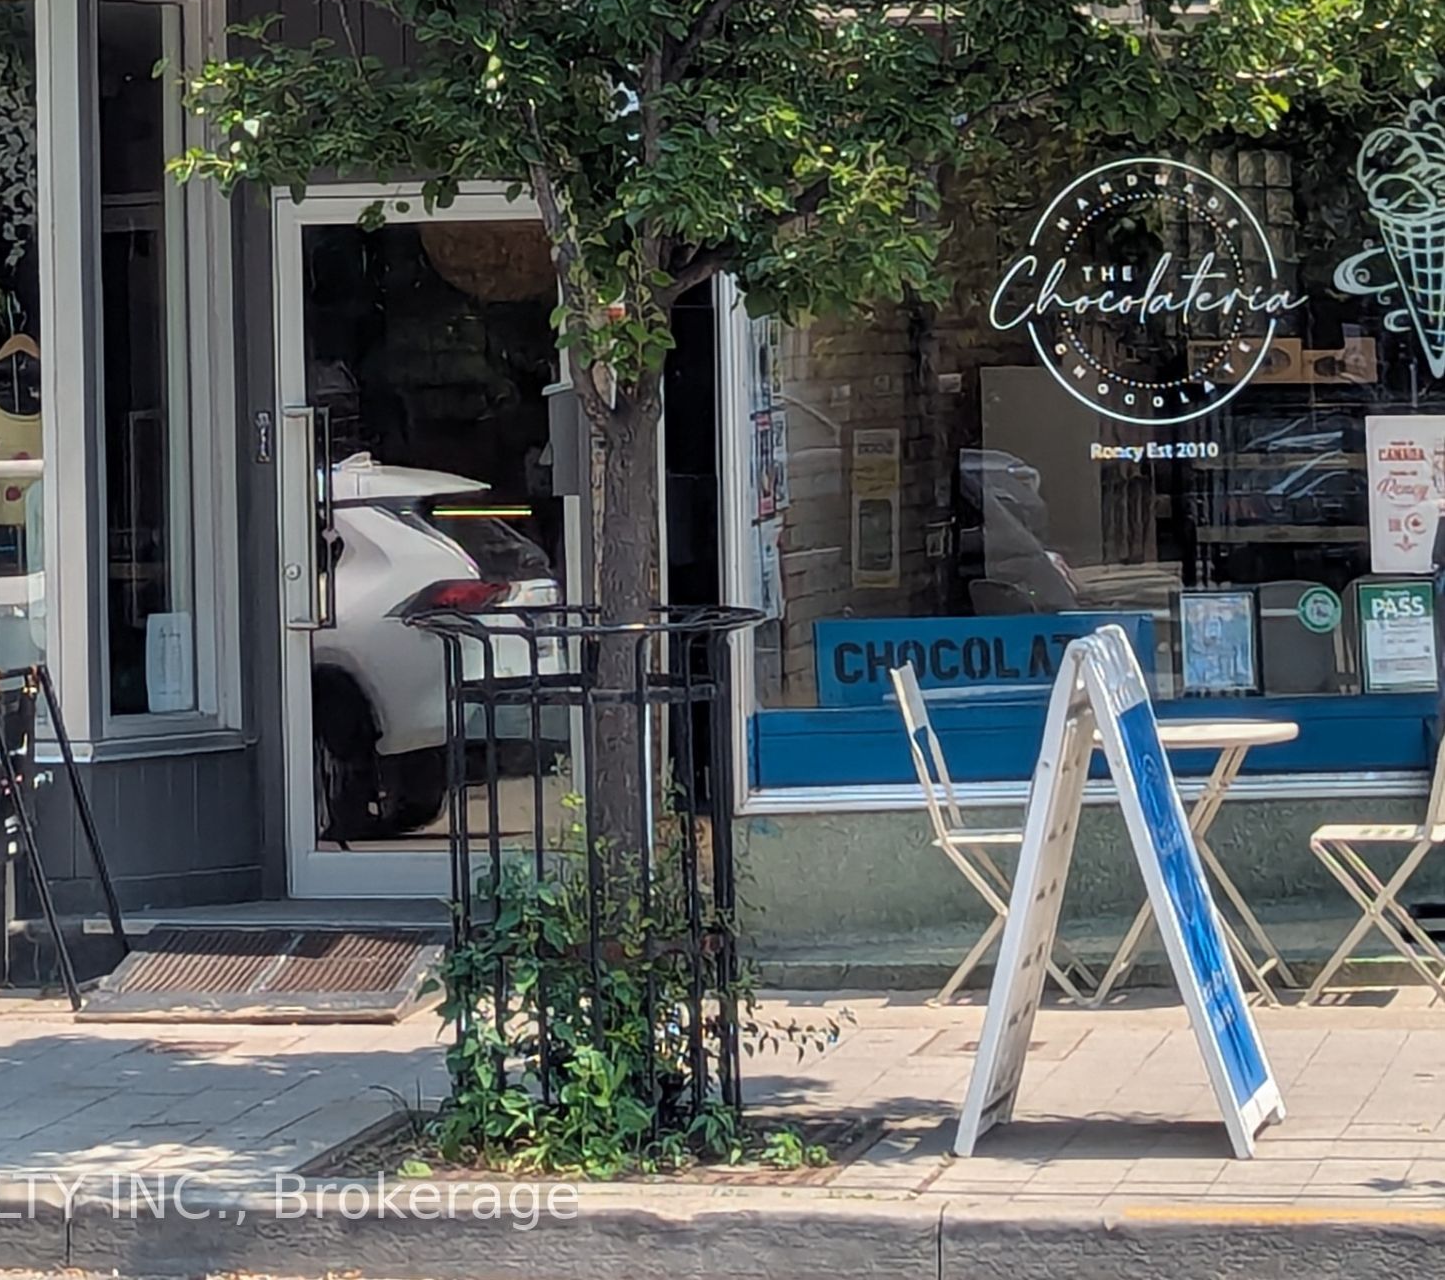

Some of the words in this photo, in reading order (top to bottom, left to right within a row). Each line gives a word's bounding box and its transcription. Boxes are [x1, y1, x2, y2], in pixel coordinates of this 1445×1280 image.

[1056, 173, 1240, 232] HANDMADE
[989, 251, 1309, 330] Chocolateria
[1081, 265, 1133, 282] THE
[1054, 341, 1252, 409] CHOCOLATE
[1146, 441, 1173, 459] Est
[1176, 441, 1219, 458] 2010
[1371, 595, 1425, 619] PASS
